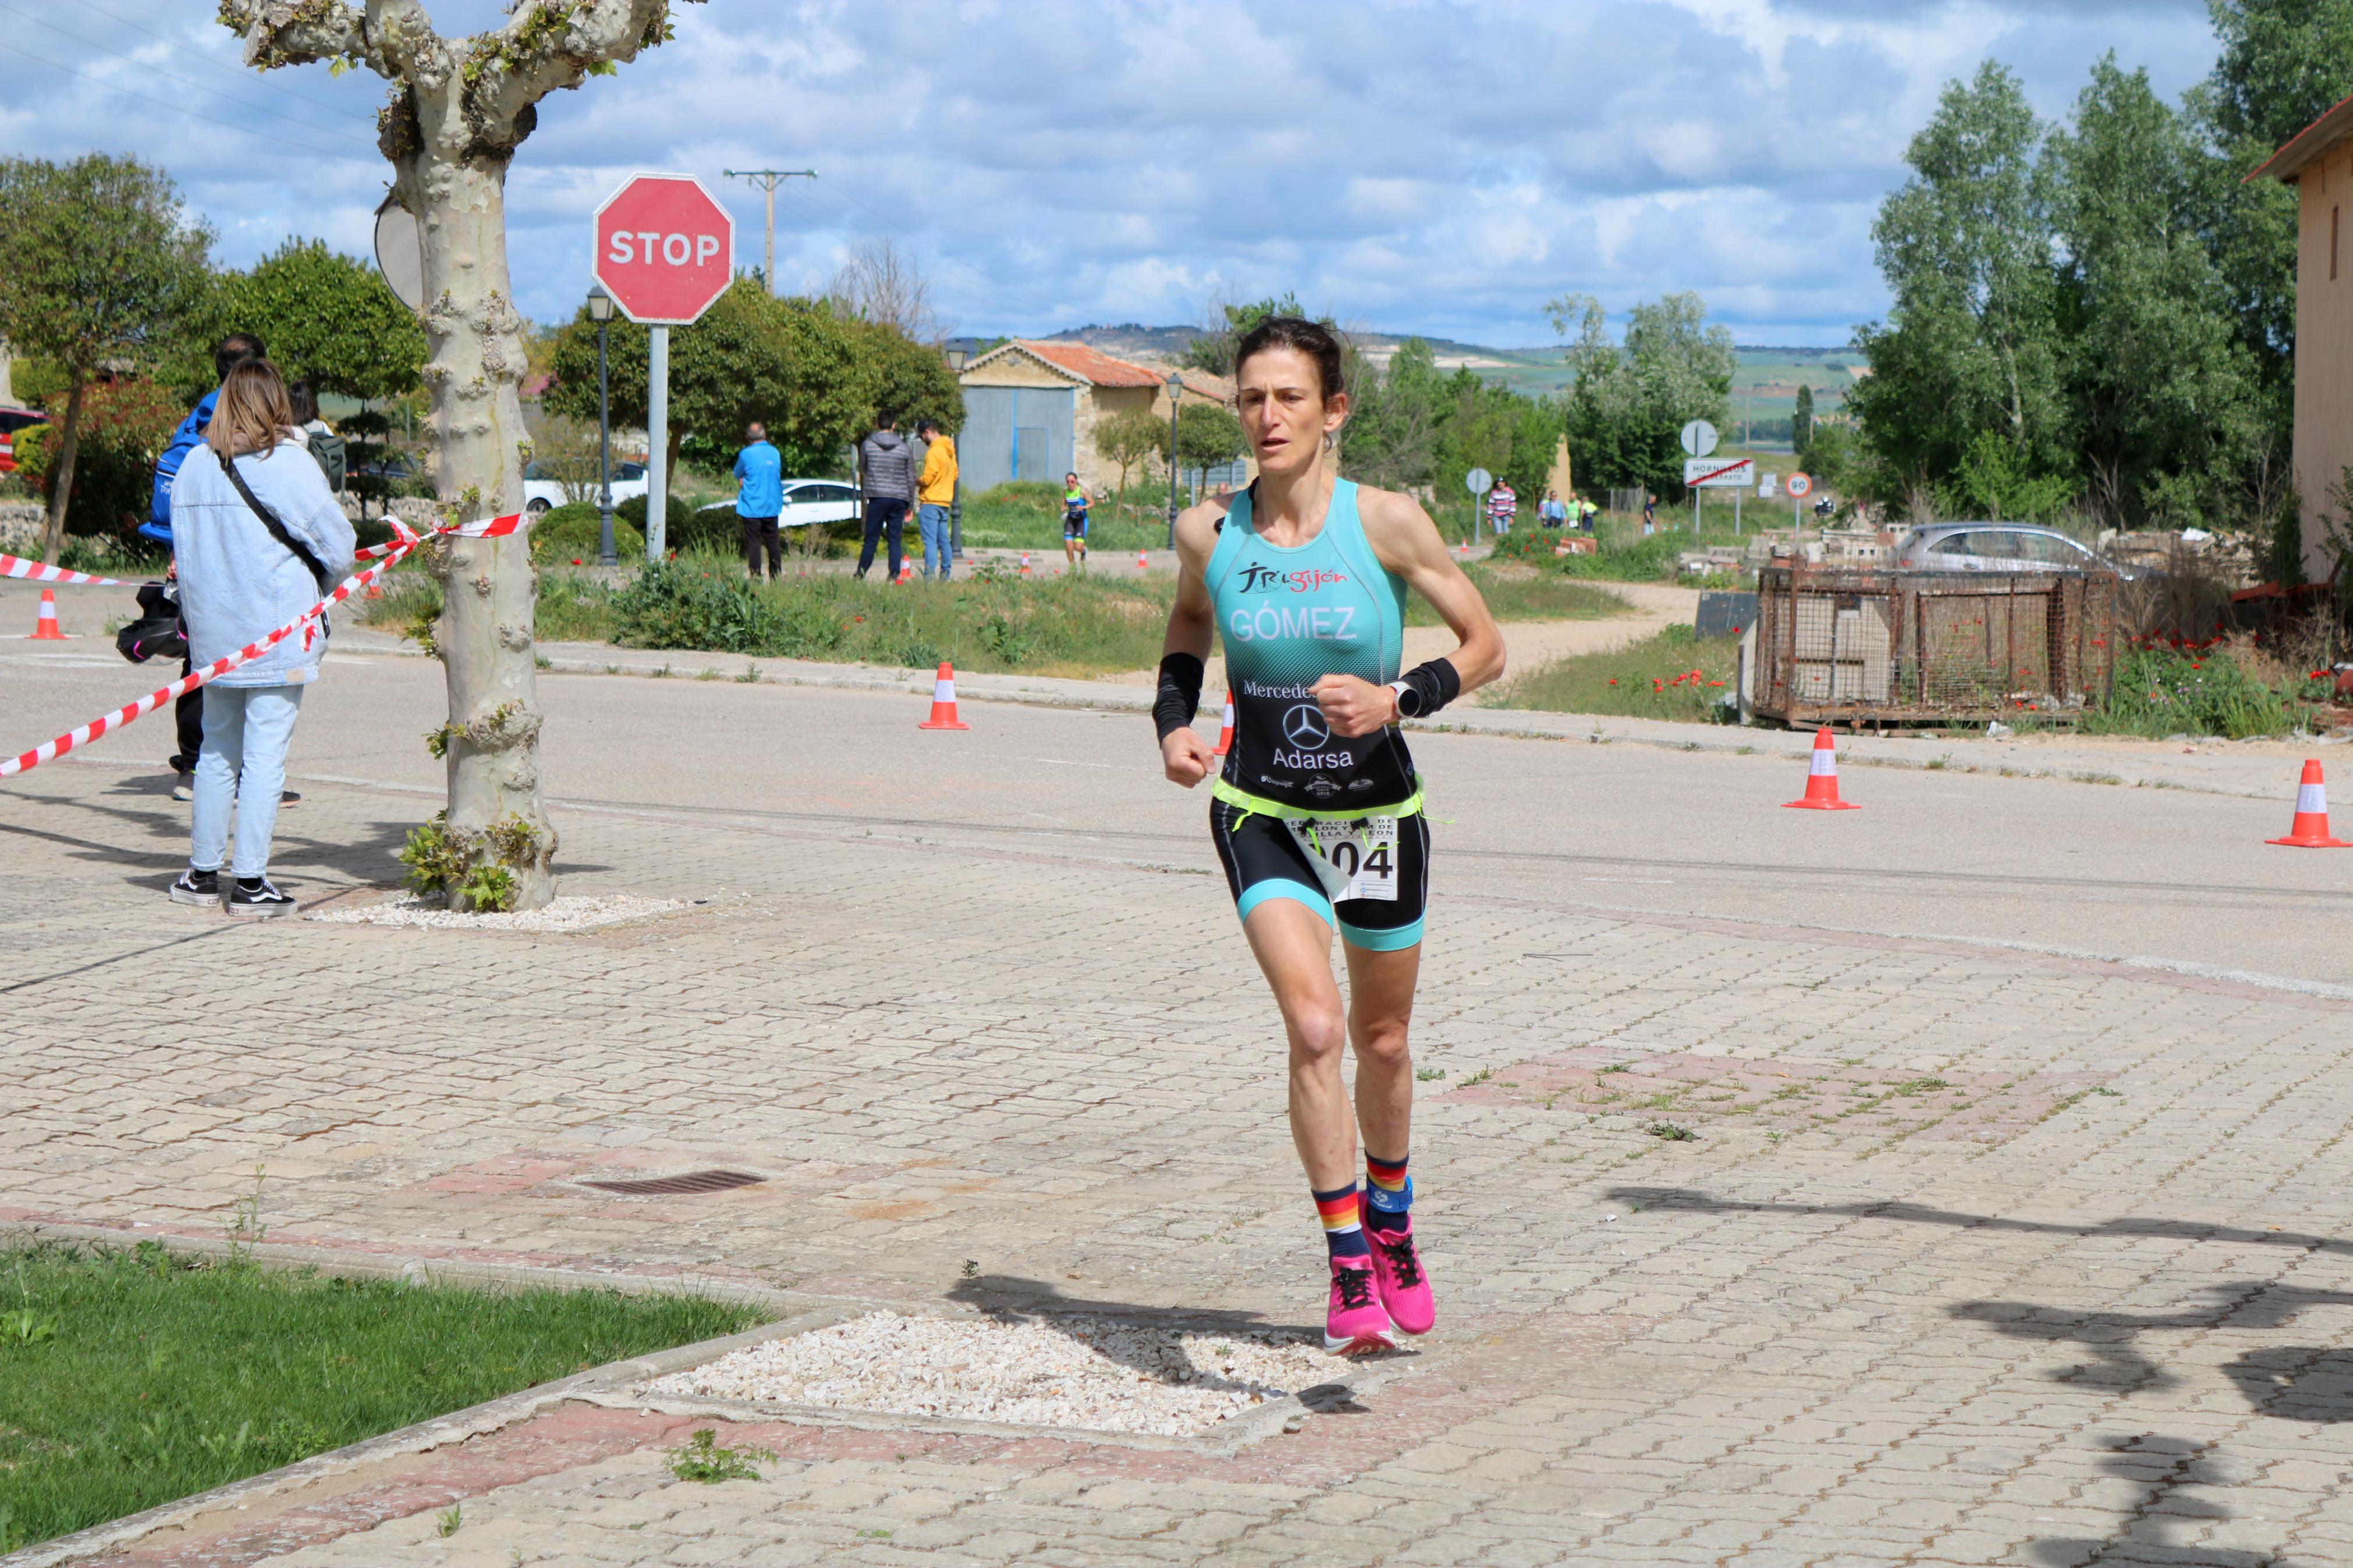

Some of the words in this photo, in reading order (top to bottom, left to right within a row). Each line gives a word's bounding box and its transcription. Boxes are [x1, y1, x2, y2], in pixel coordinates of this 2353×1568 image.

[609, 230, 719, 266] STOP
[1791, 481, 1806, 490] 90
[1230, 600, 1357, 642] GÓMEZ
[1273, 748, 1354, 769] Adarsa
